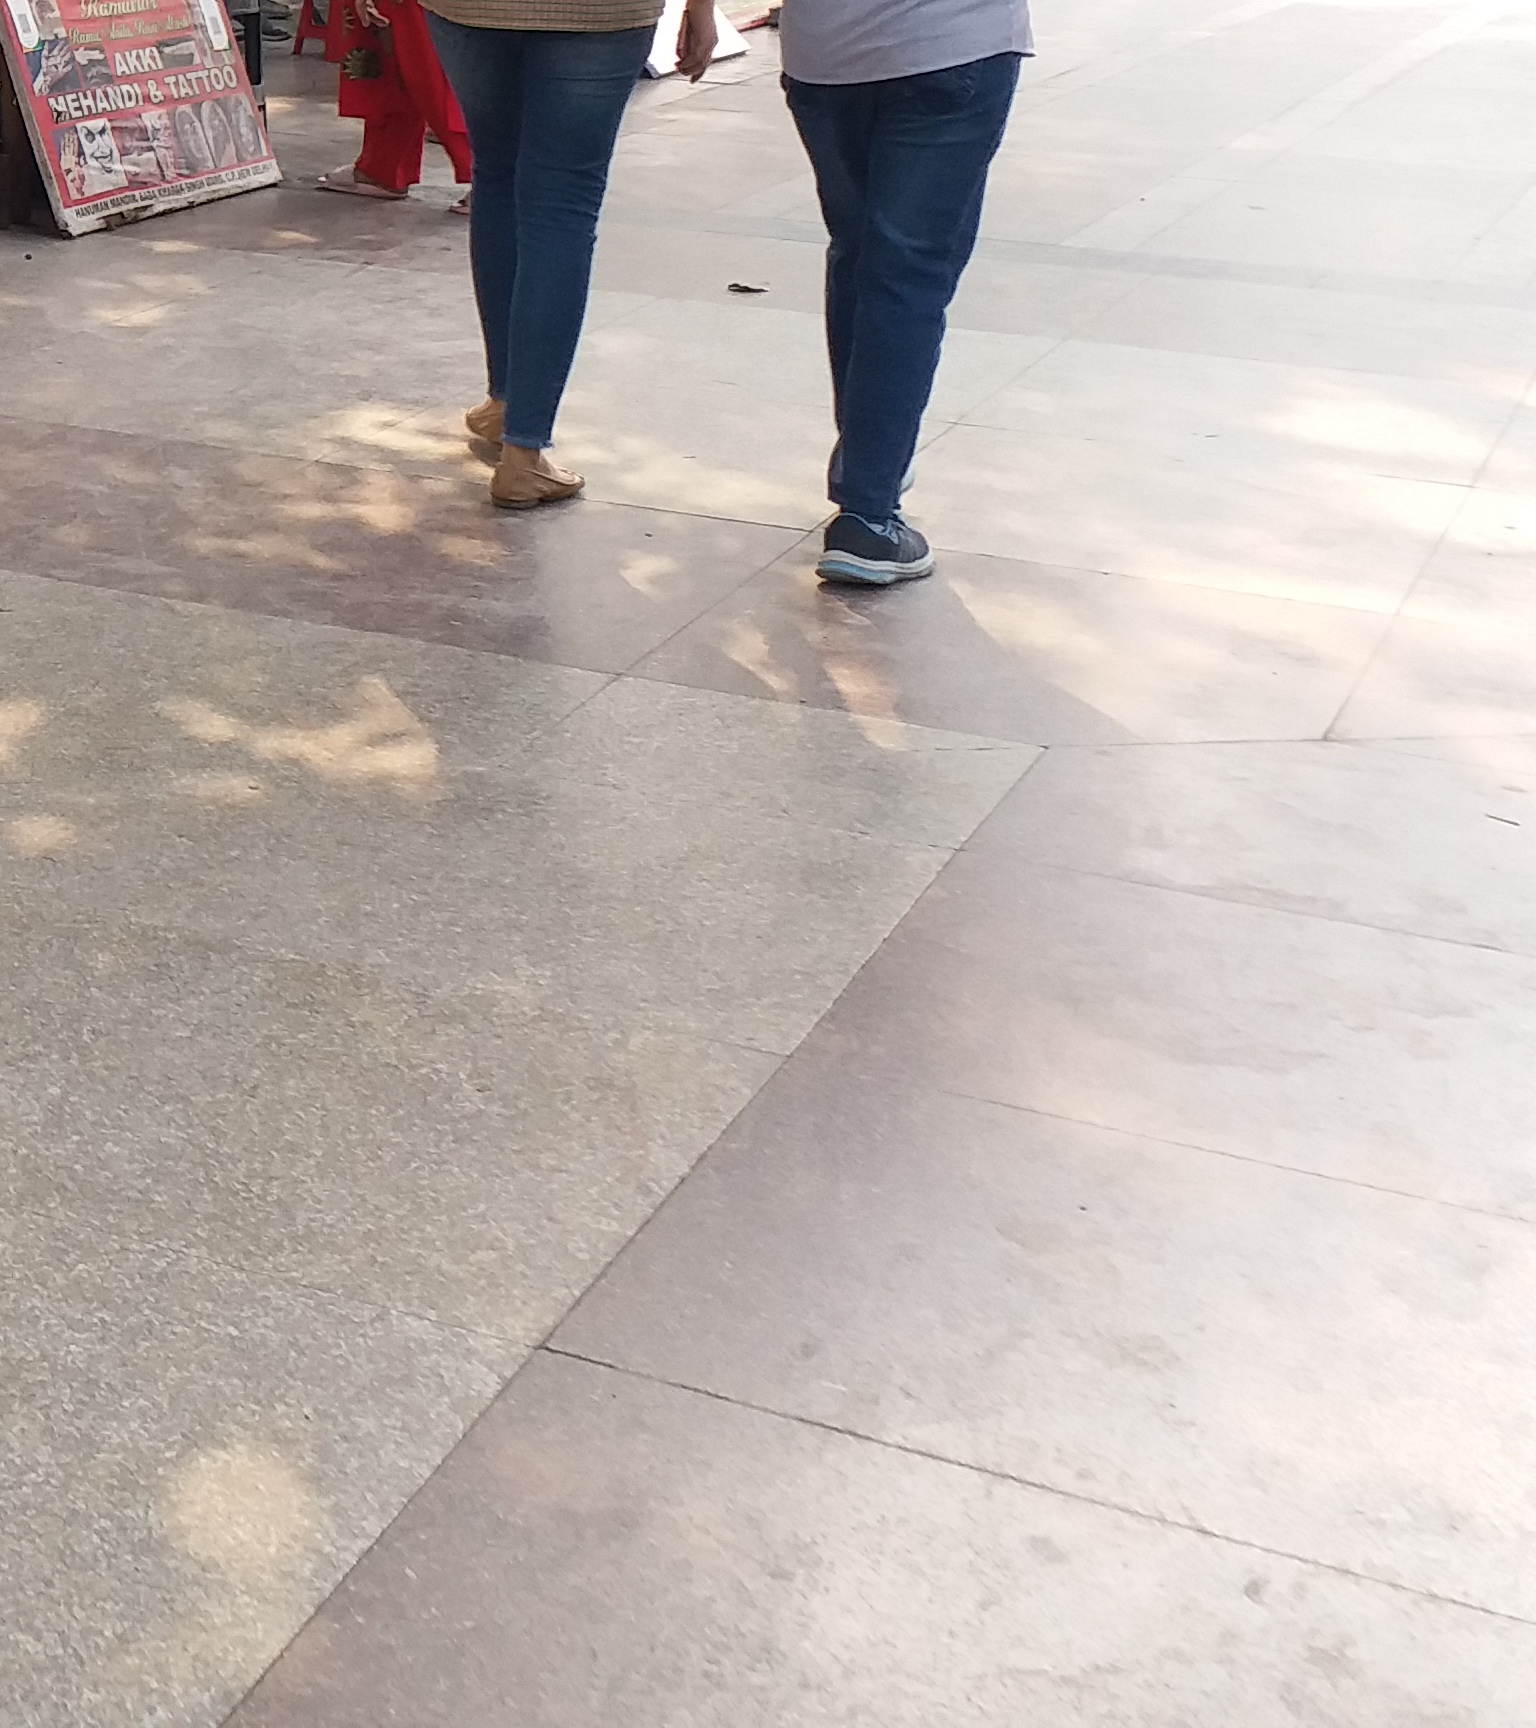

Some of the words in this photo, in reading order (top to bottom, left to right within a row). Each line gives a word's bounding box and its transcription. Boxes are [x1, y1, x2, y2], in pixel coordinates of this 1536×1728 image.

[114, 46, 164, 77] AKKI
[47, 82, 144, 123] MEHANDI
[147, 76, 165, 105] &
[164, 64, 238, 100] TATTOO
[75, 200, 111, 219] HANUMAN
